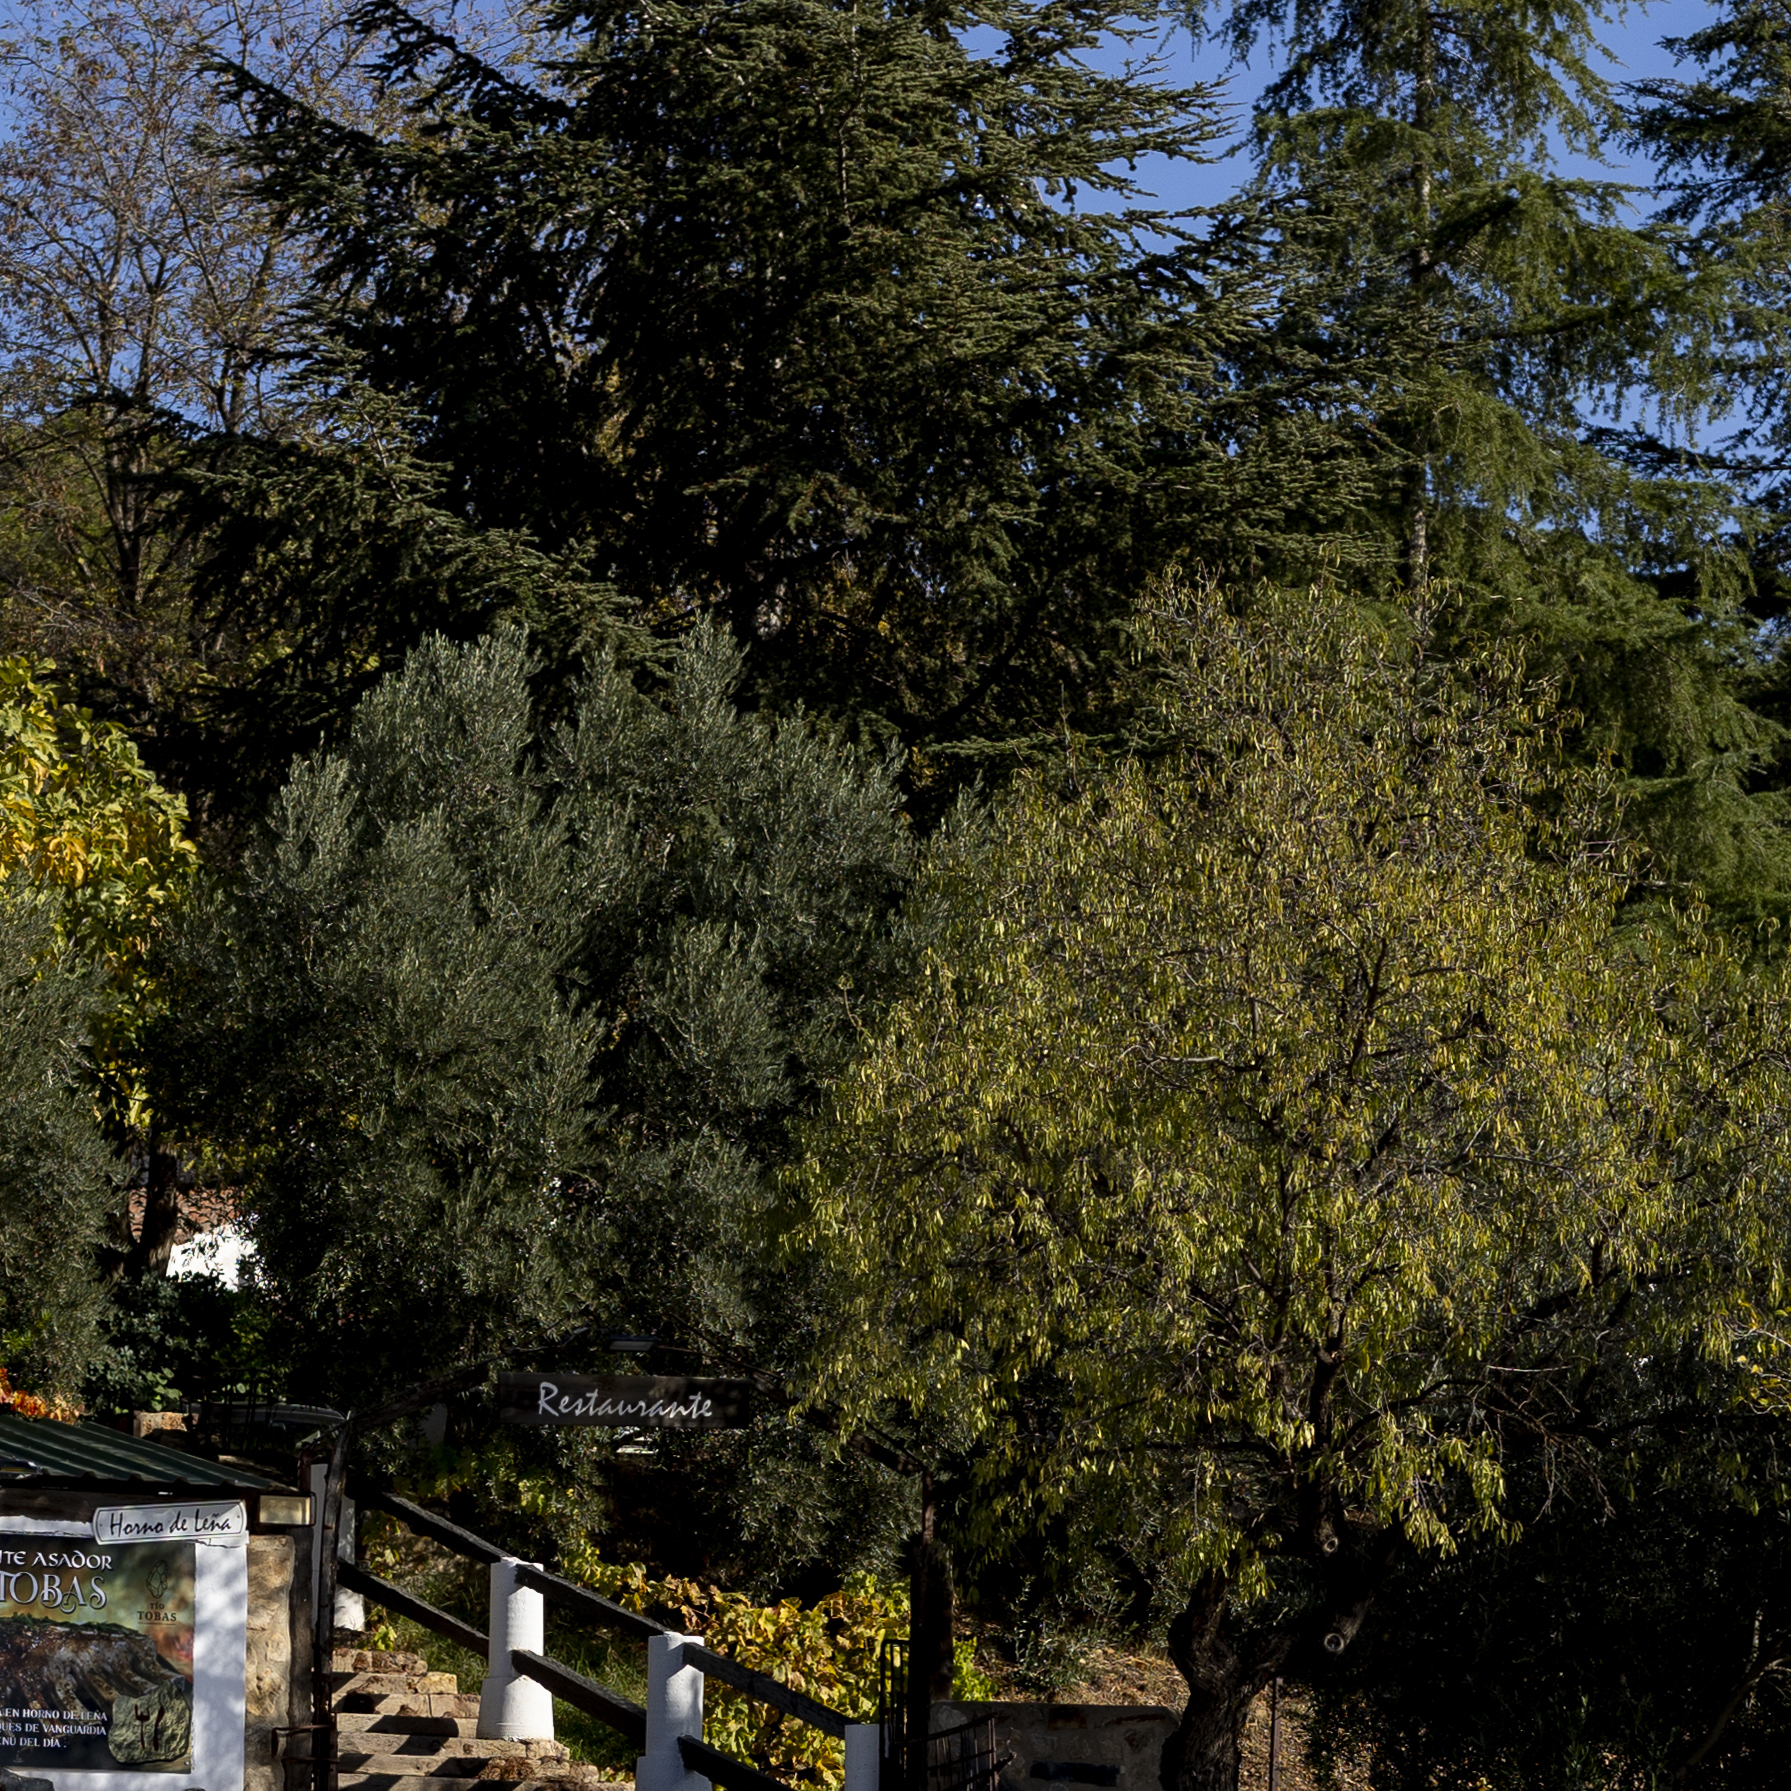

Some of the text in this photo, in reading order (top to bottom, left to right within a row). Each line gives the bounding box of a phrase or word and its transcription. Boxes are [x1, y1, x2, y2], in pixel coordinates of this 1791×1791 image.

[538, 1381, 713, 1419] Restaurante
[110, 1509, 231, 1537] Horno de Leña
[31, 1550, 112, 1571] ASADOR
[137, 1611, 177, 1622] TOBAS
[5, 1707, 20, 1718] EN
[22, 1708, 60, 1719] HORNO
[63, 1710, 78, 1720] DE
[25, 1723, 39, 1732] DE
[42, 1723, 106, 1735] VANGUARDIA
[19, 1737, 40, 1747] DEL
